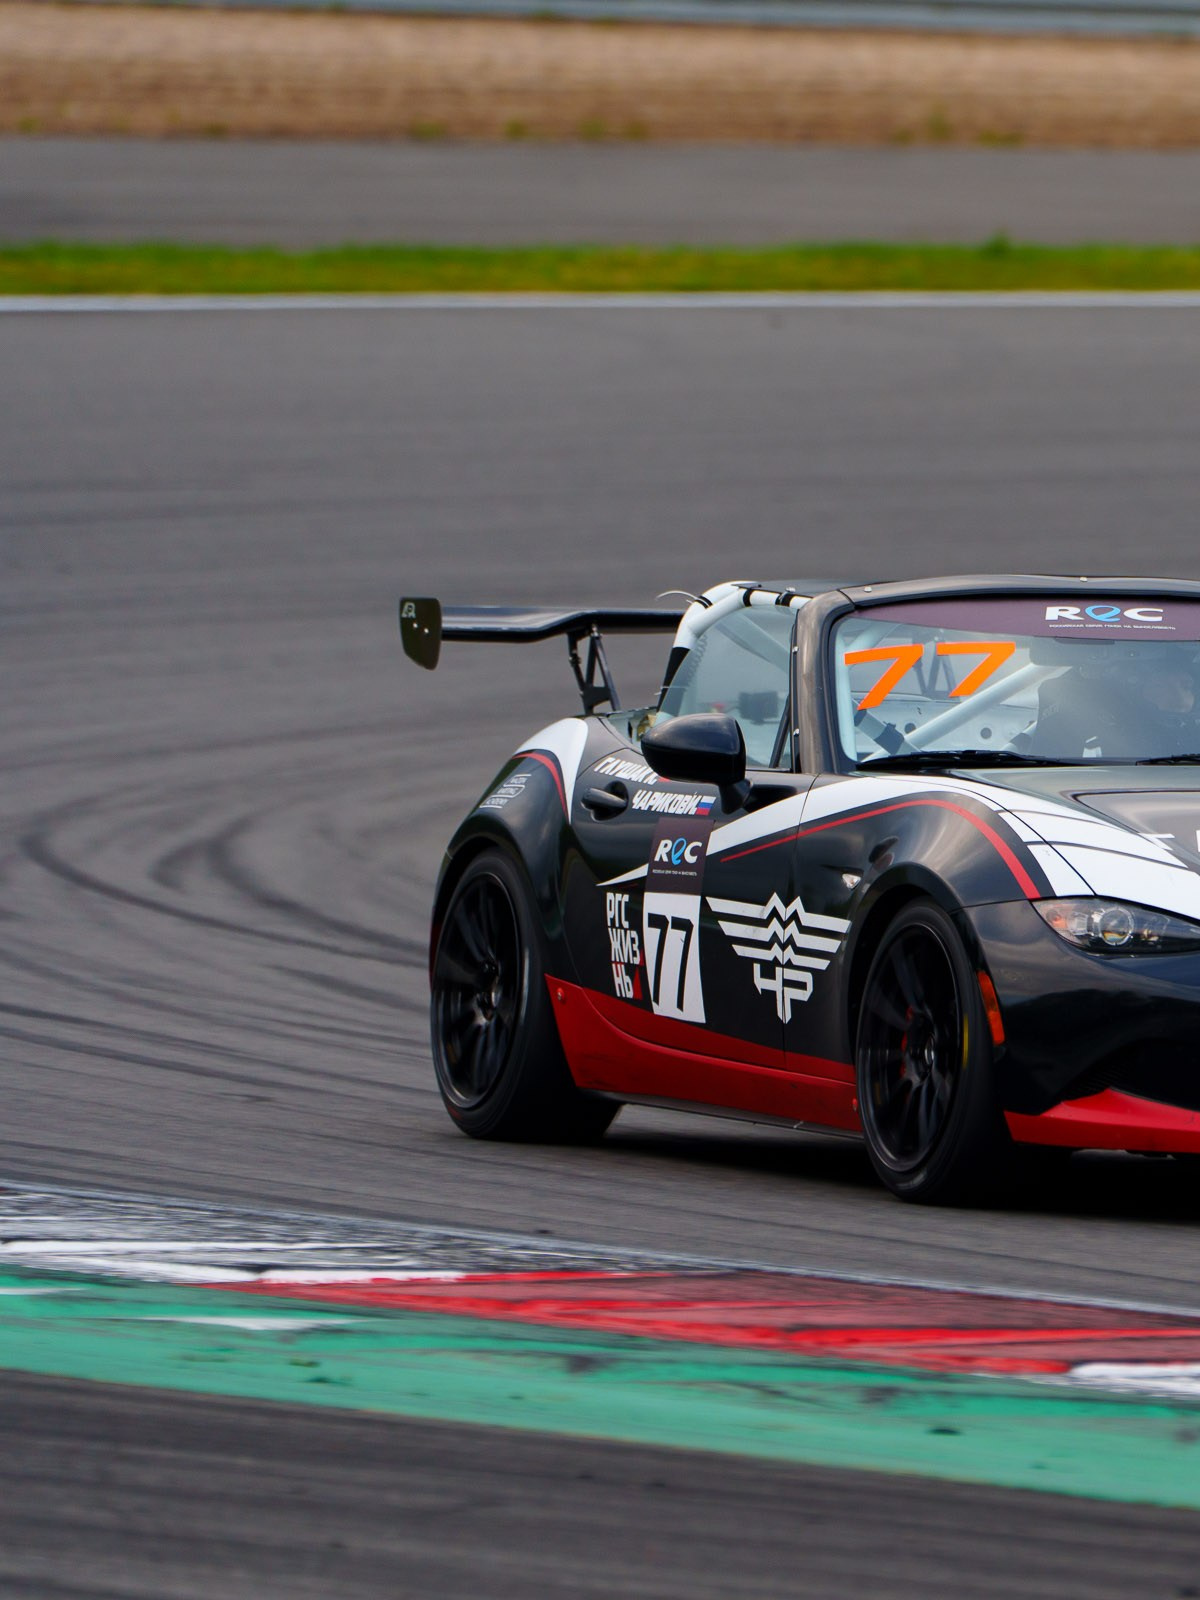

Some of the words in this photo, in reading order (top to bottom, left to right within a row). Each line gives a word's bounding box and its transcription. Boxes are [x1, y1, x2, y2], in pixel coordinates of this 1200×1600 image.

[844, 641, 1016, 711] 77
[606, 892, 629, 928] РГС
[648, 912, 694, 1012] 77
